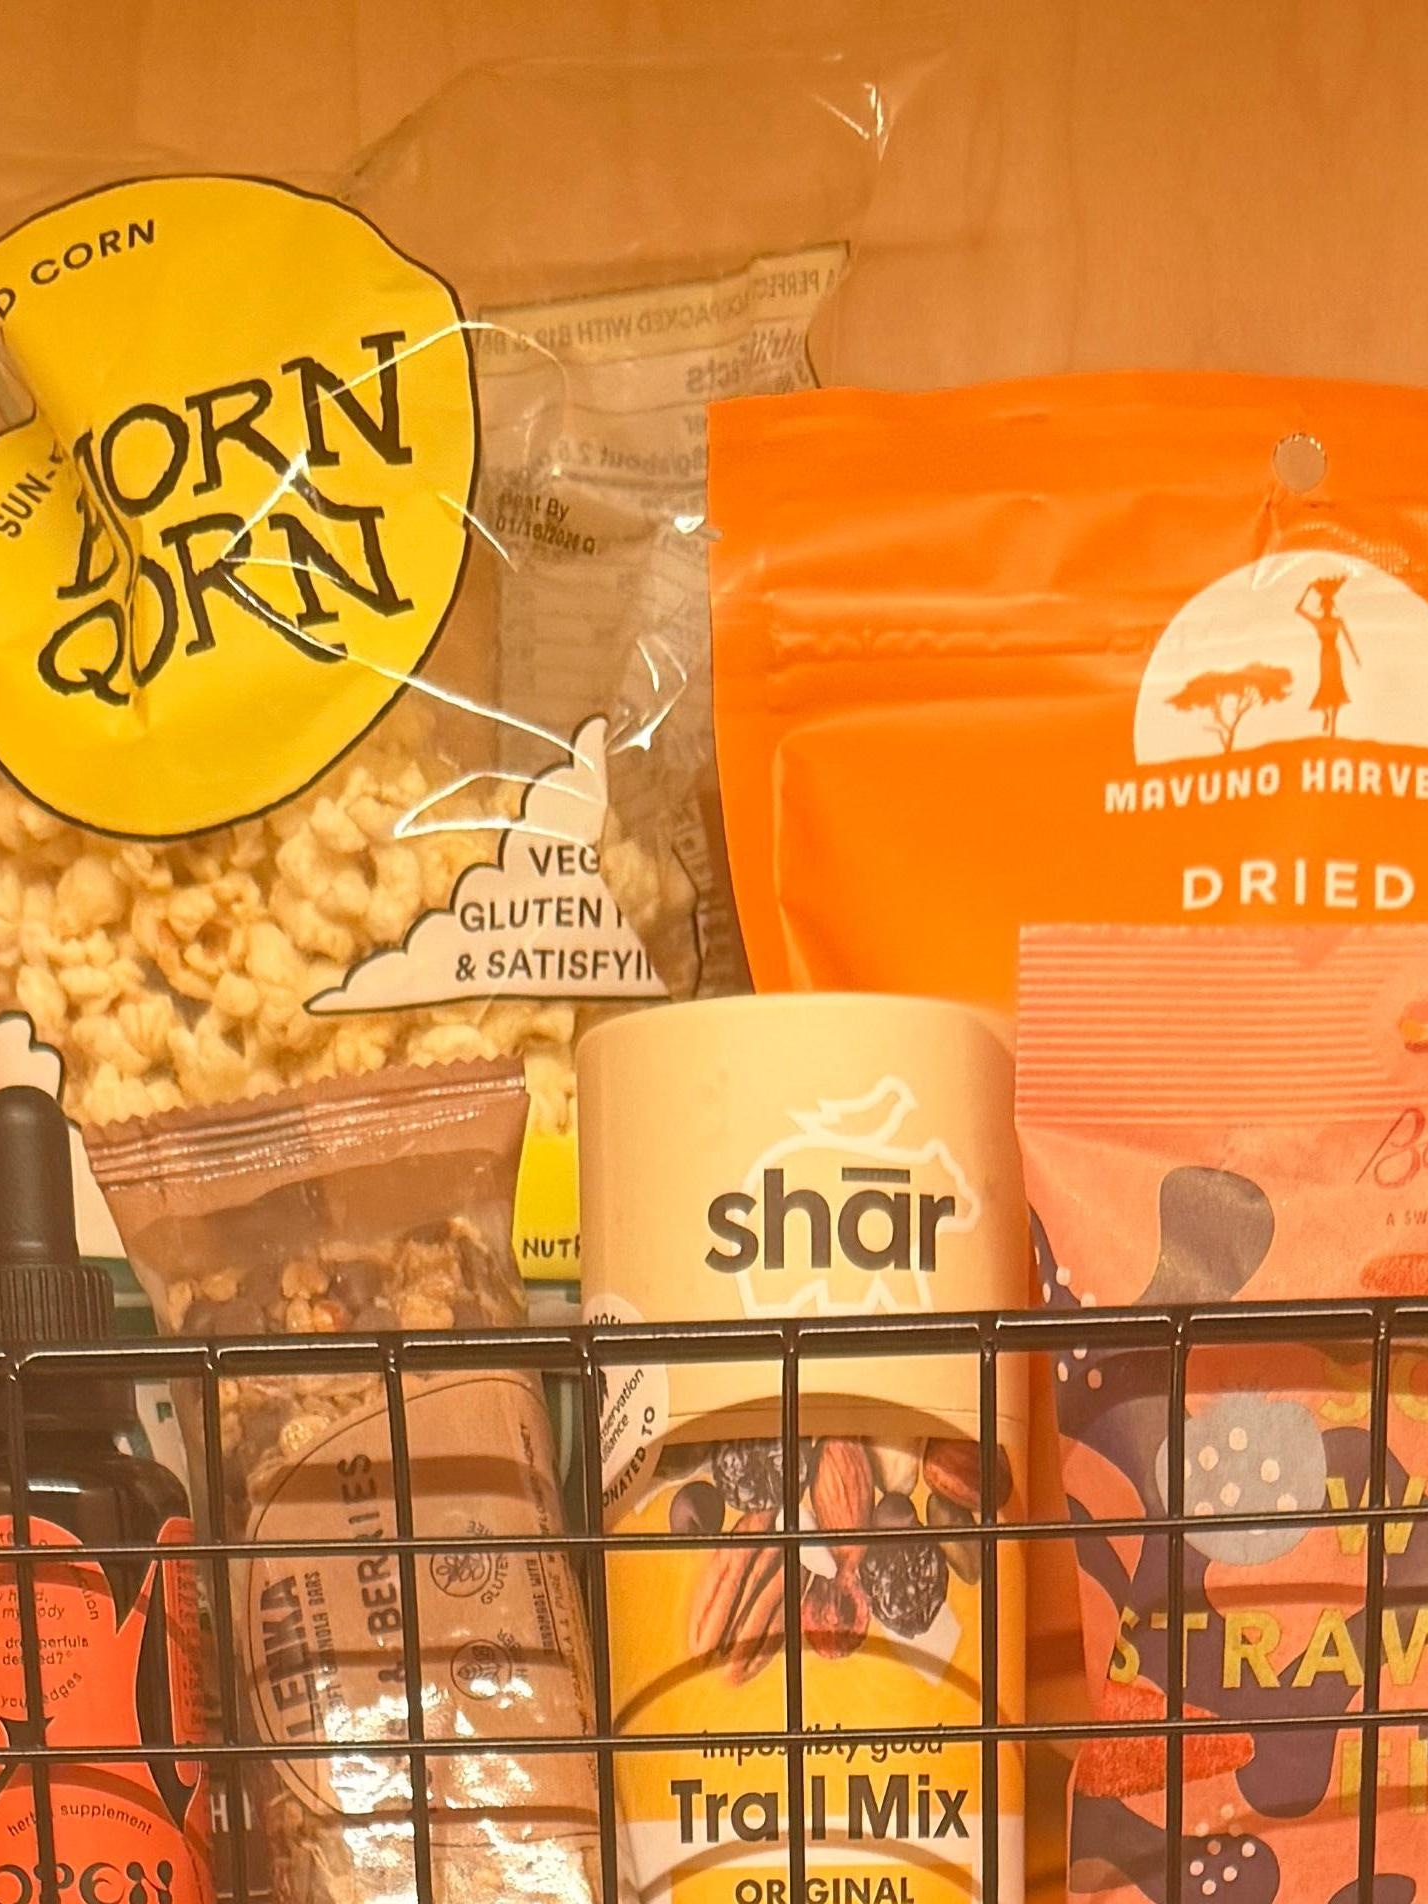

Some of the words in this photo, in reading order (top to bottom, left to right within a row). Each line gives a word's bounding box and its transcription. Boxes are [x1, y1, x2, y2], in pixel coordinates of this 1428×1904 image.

[30, 219, 154, 285] CORN
[547, 498, 570, 522] By
[1104, 764, 1280, 813] MAVUNO
[528, 845, 601, 877] VEG
[1182, 857, 1415, 911] DRIED
[459, 896, 603, 932] GLUTEN
[455, 951, 478, 981] &
[486, 948, 652, 982] SATISFYI
[705, 1167, 954, 1274] shār
[1386, 1212, 1395, 1227] A
[602, 1446, 646, 1507] ONATED
[642, 1406, 656, 1437] TO
[38, 1605, 66, 1621] ody
[61, 1803, 153, 1836] supplement
[670, 1775, 826, 1844] Tral
[849, 1774, 970, 1839] Mix
